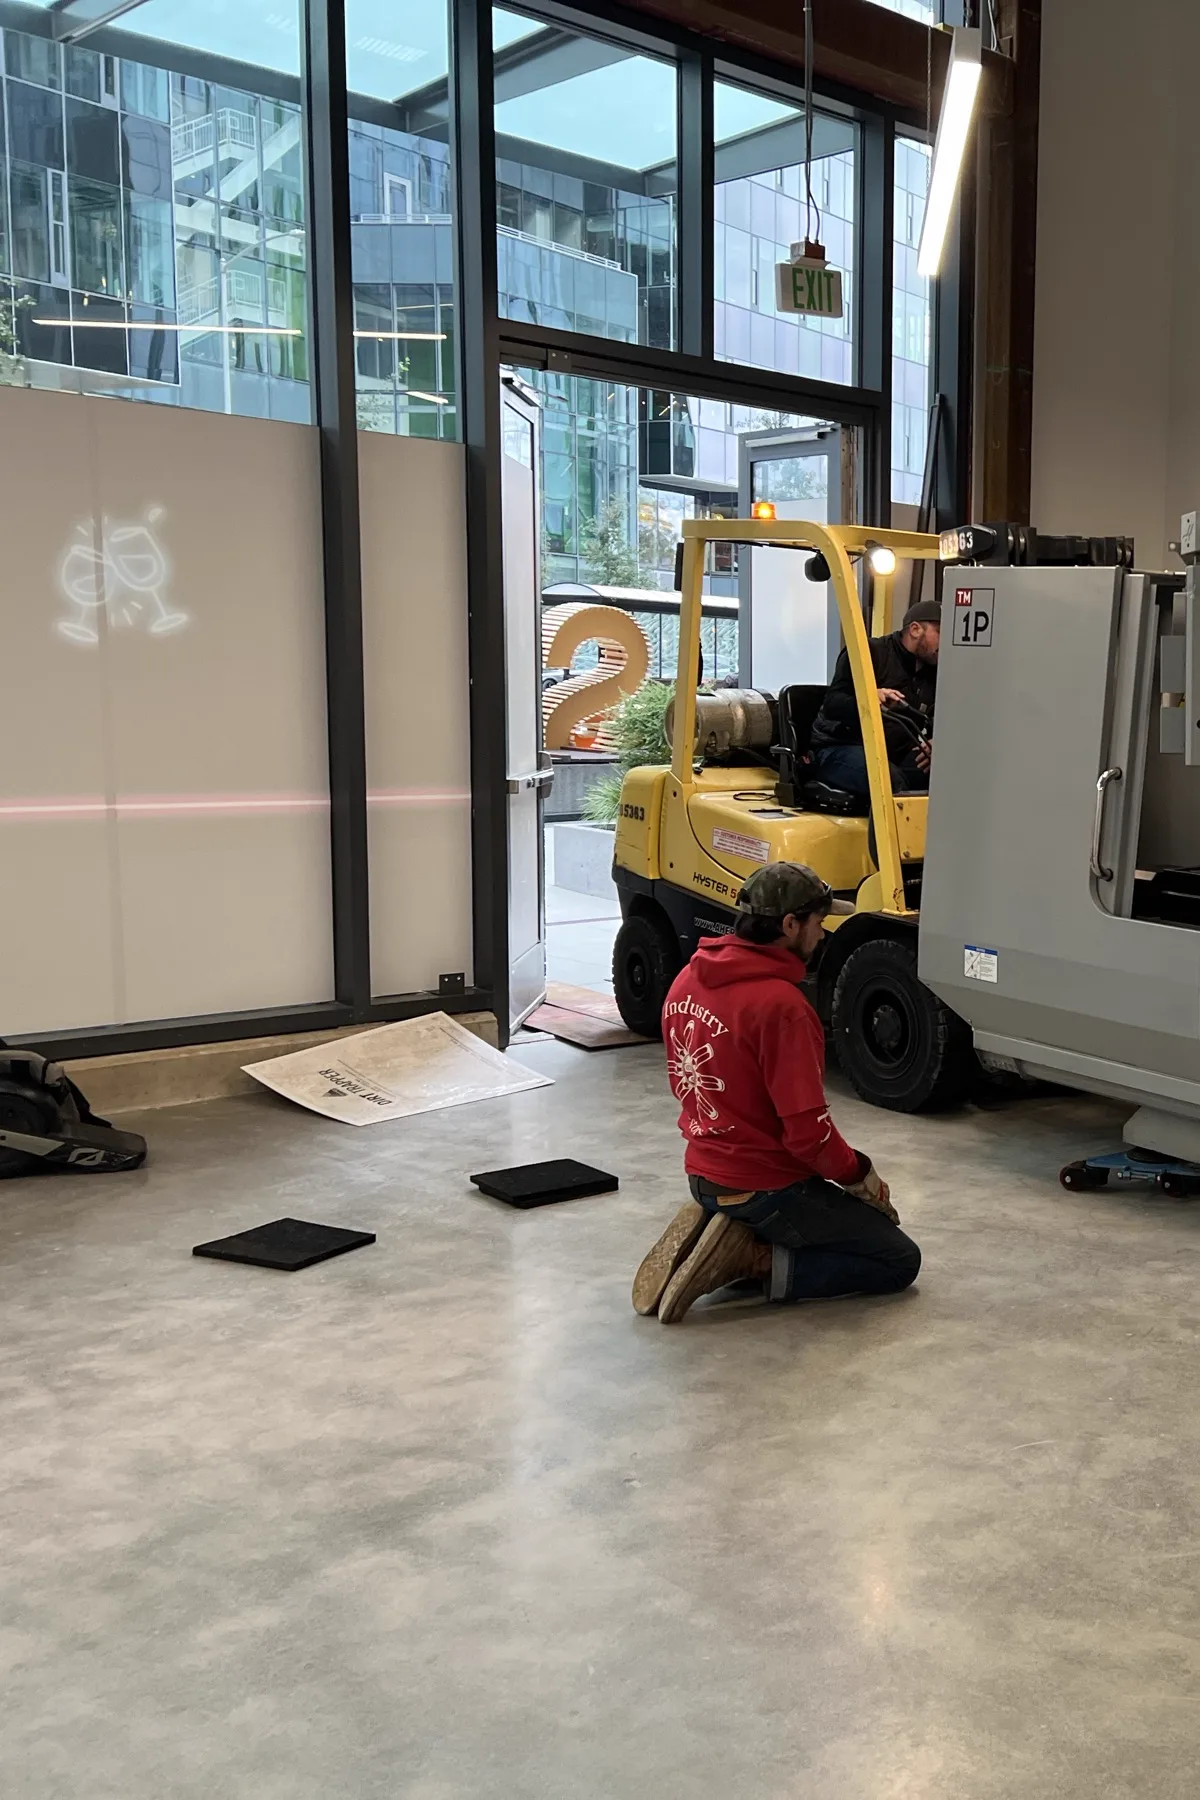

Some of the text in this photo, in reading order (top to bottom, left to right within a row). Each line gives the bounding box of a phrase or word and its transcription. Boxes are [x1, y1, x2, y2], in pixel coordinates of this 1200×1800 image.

[791, 267, 834, 313] EXIT
[957, 591, 972, 604] TM
[961, 610, 990, 642] 1P
[692, 871, 729, 896] HYSTER
[694, 916, 736, 936] WWW.AHER
[664, 994, 730, 1038] Industry
[318, 1068, 366, 1095] TRAPPER
[358, 1091, 393, 1106] DIRT
